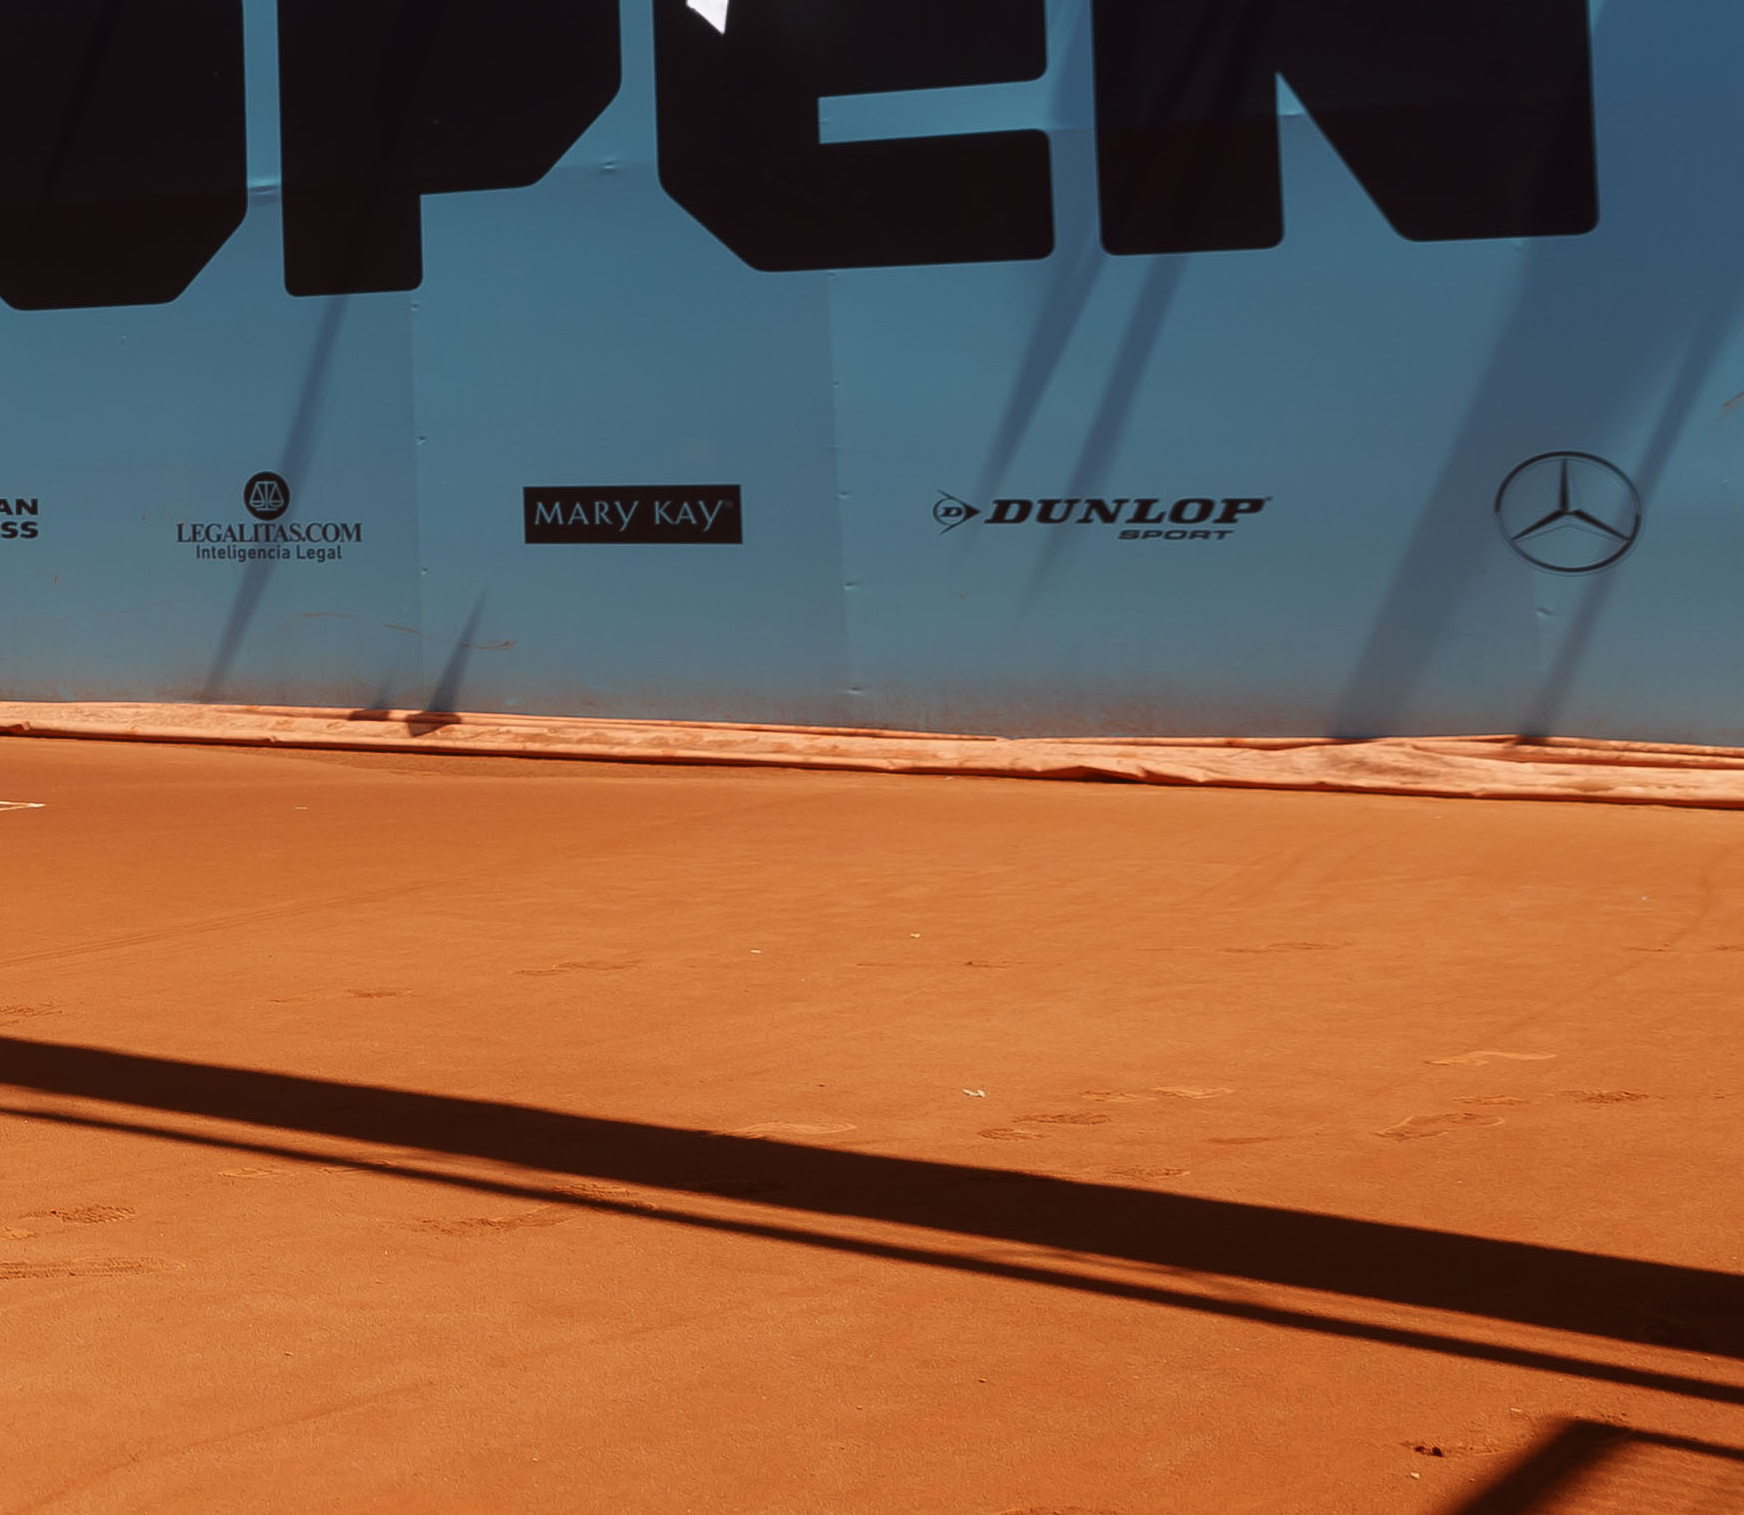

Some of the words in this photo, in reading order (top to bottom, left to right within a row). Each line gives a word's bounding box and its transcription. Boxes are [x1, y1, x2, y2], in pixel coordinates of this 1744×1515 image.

[534, 500, 639, 533] MARY
[654, 499, 724, 533] KAY
[983, 498, 1267, 525] DUNLOP
[176, 522, 363, 543] LEGALITAS.COM
[1117, 529, 1234, 541] SPORT
[196, 544, 291, 563] Inteligencia
[296, 545, 342, 563] Legal
